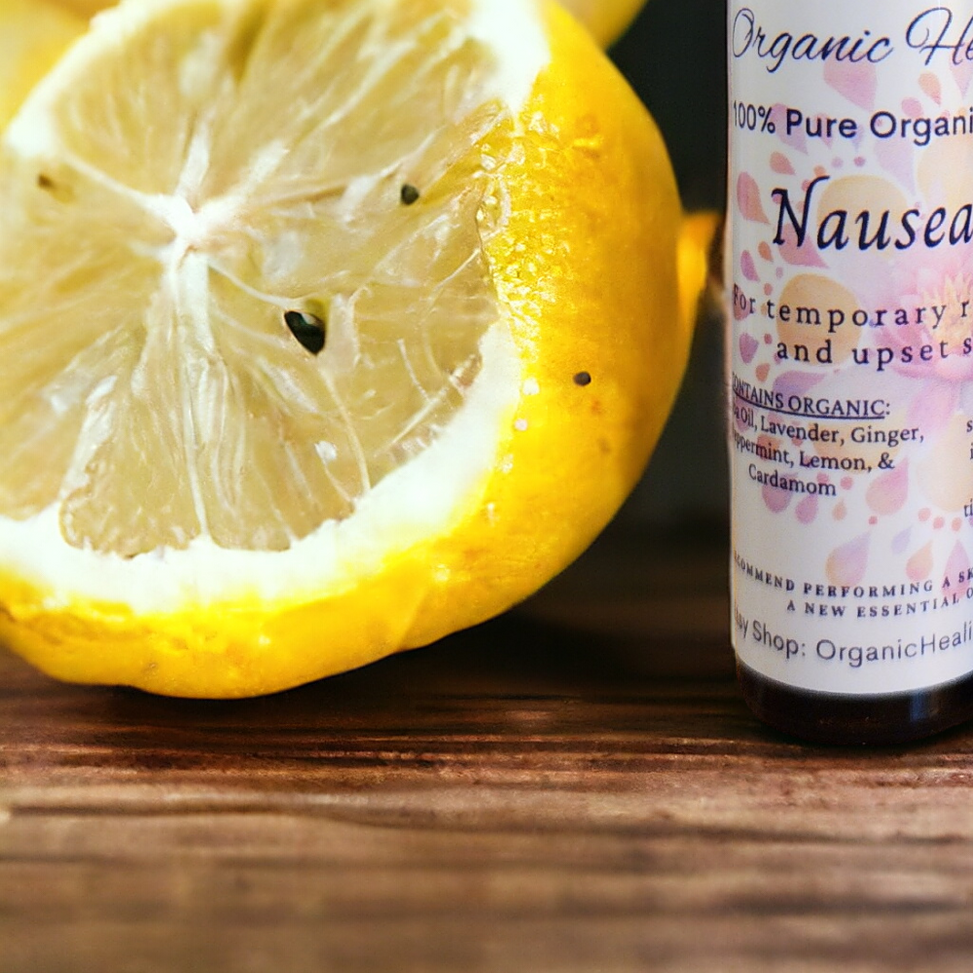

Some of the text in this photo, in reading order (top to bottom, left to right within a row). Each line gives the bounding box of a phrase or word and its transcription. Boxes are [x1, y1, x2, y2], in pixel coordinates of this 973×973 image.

[733, 8, 894, 73] Organic
[733, 100, 776, 134] 100%
[786, 108, 857, 138] Pure
[771, 176, 973, 250] Nausea
[733, 283, 757, 314] For
[766, 300, 947, 333] temporary
[777, 339, 833, 364] and
[852, 340, 950, 371] upset
[732, 372, 891, 418] ONTAINS ORGANIC:
[761, 415, 846, 446] Lavender,
[850, 426, 925, 448] Ginger,
[748, 463, 837, 496] Cardamom
[799, 450, 872, 474] Lemon,
[878, 452, 895, 470] &
[786, 600, 796, 612] A
[804, 602, 847, 617] NEW
[856, 592, 960, 618] ESSENTIAL
[803, 579, 934, 599] PERFORMING
[941, 577, 952, 590] A
[752, 619, 807, 659] Shop:
